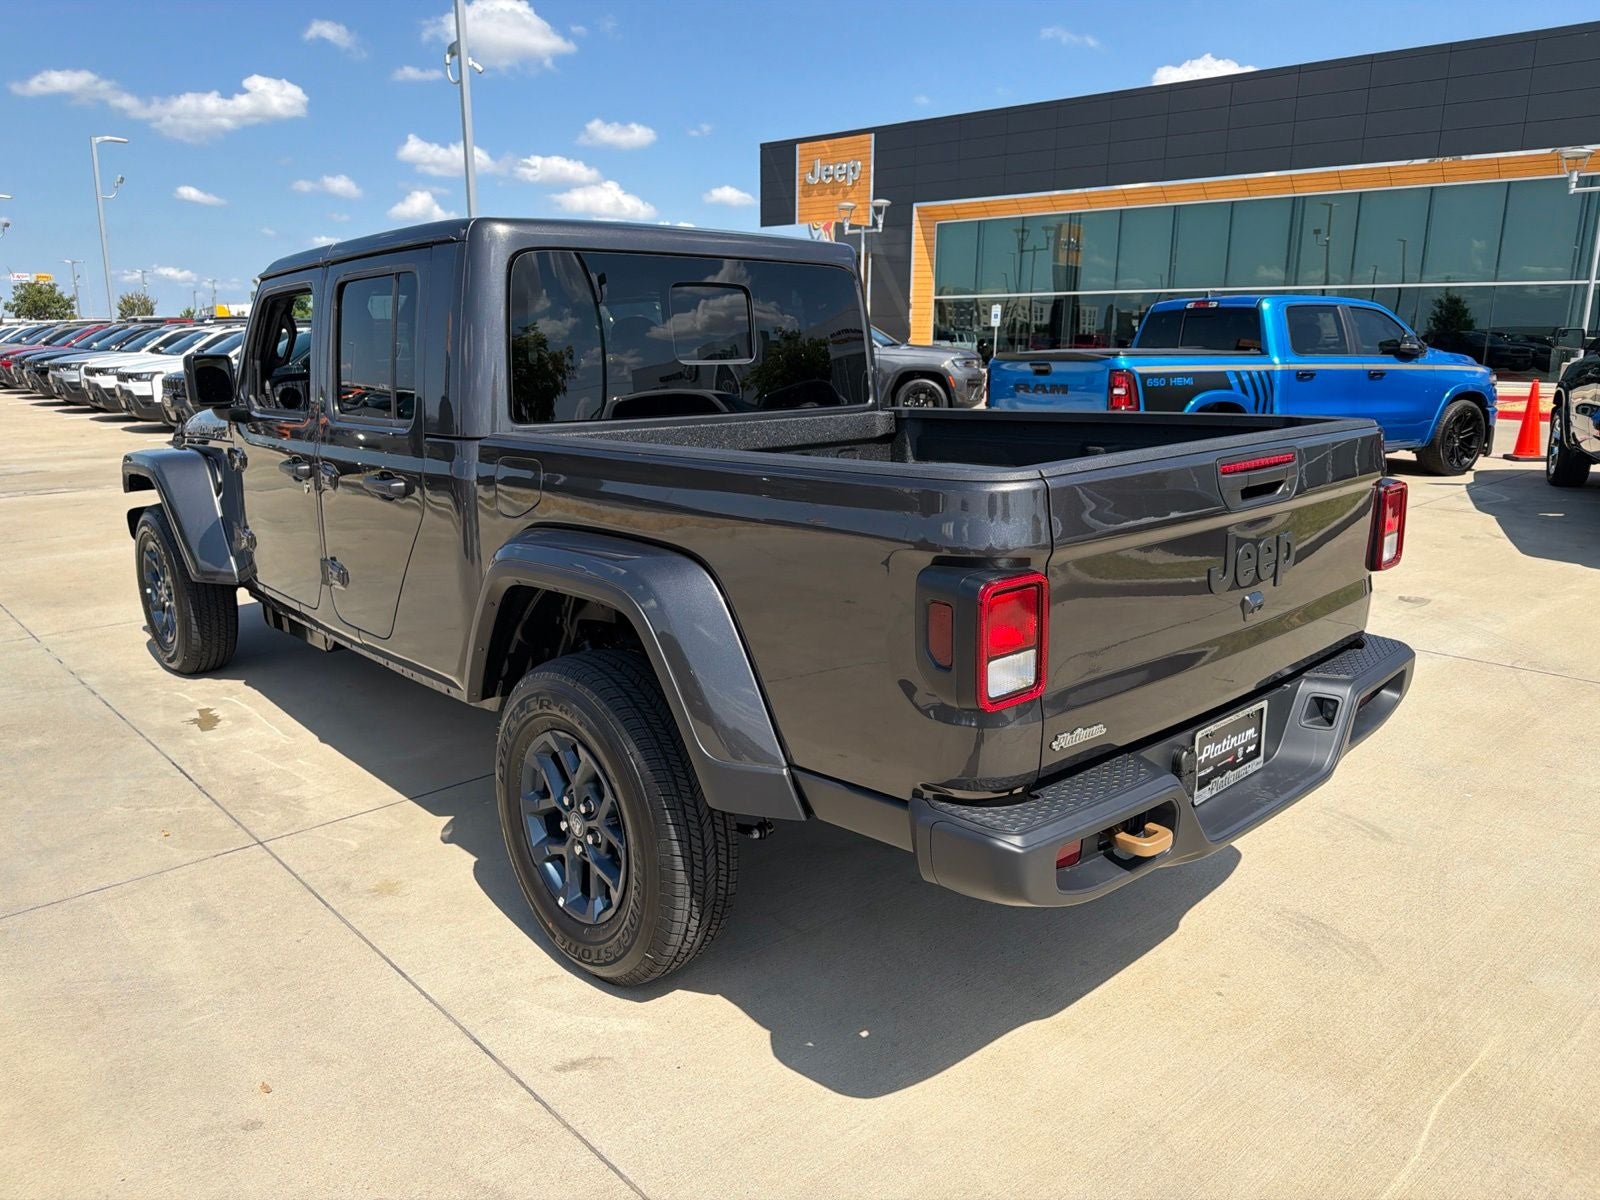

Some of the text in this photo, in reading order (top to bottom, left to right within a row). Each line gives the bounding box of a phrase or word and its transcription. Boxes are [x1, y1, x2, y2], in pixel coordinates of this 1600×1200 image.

[805, 158, 862, 186] Jeep
[1015, 383, 1069, 395] RAM
[1147, 376, 1194, 387] 650 HEMI
[1208, 532, 1296, 594] Jeep
[1198, 727, 1258, 763] Platinum
